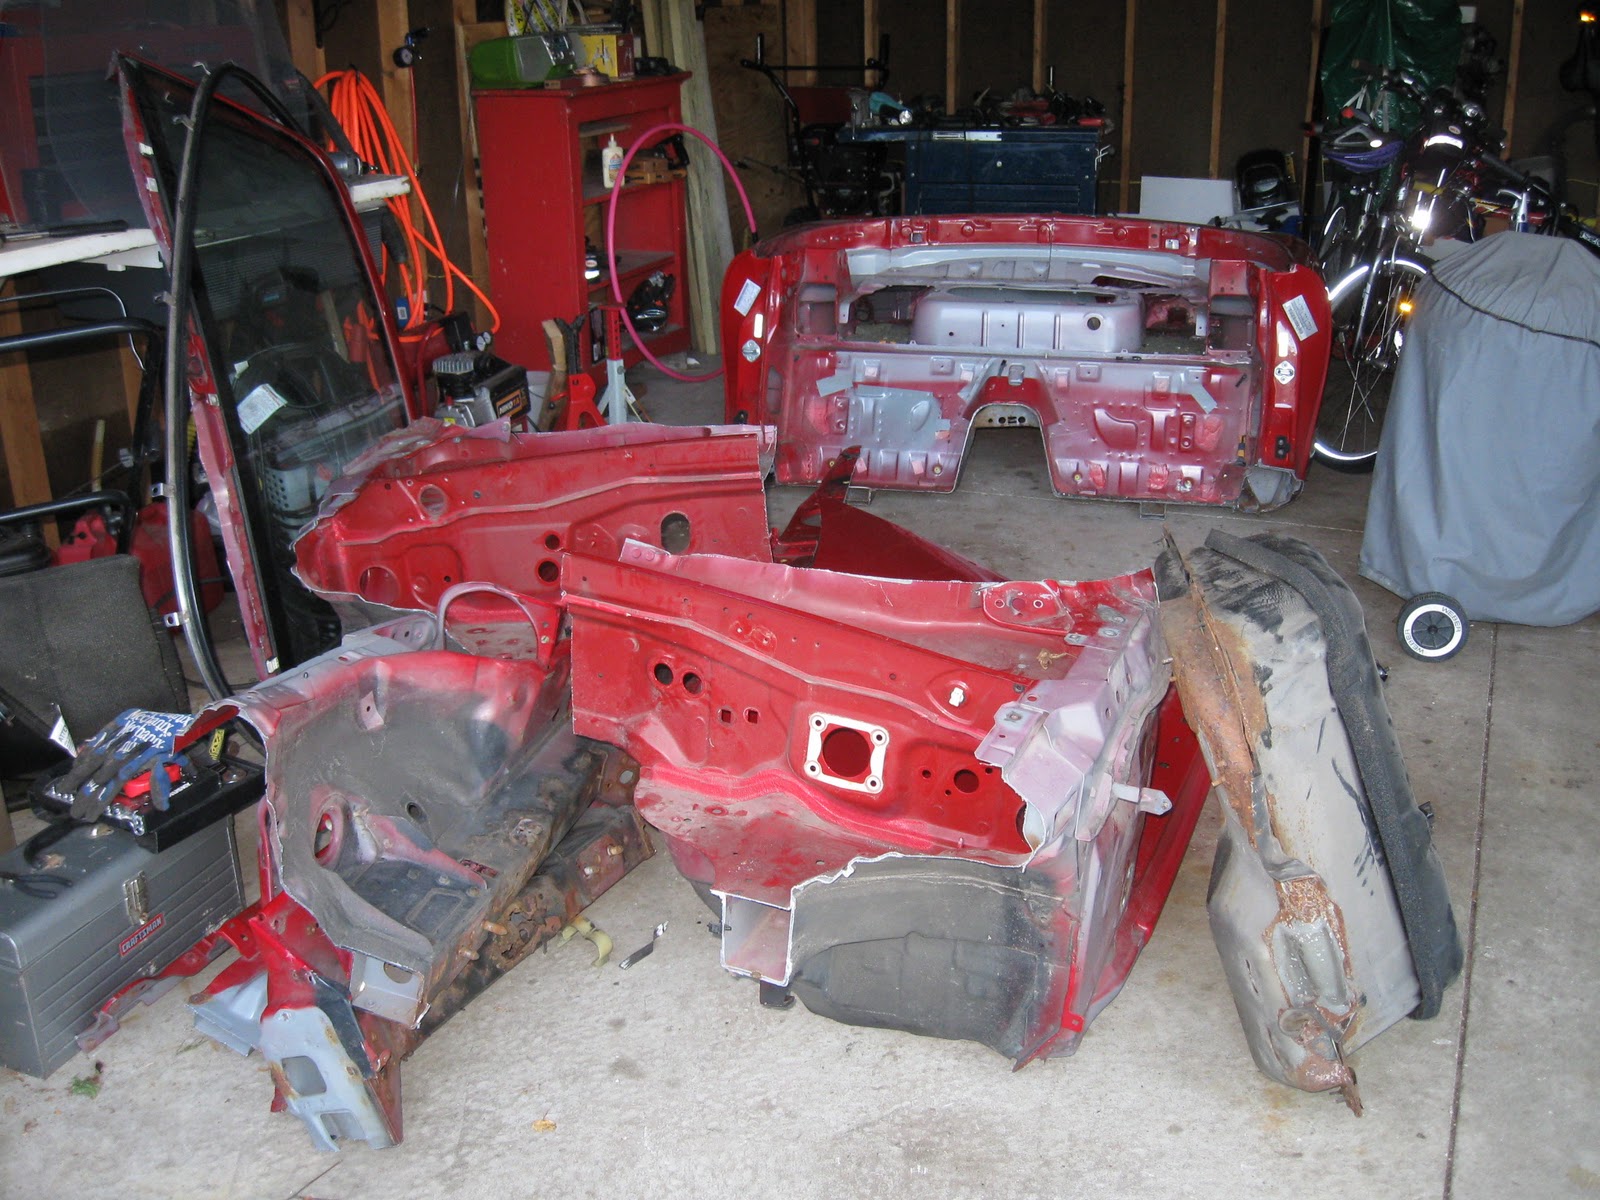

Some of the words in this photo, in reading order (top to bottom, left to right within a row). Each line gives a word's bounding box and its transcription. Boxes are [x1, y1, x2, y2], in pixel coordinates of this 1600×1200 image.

[1441, 606, 1461, 633] WEBER
[1405, 629, 1425, 654] WEBER
[124, 709, 175, 737] Mechanix
[122, 916, 162, 953] CRAFTSMAN
